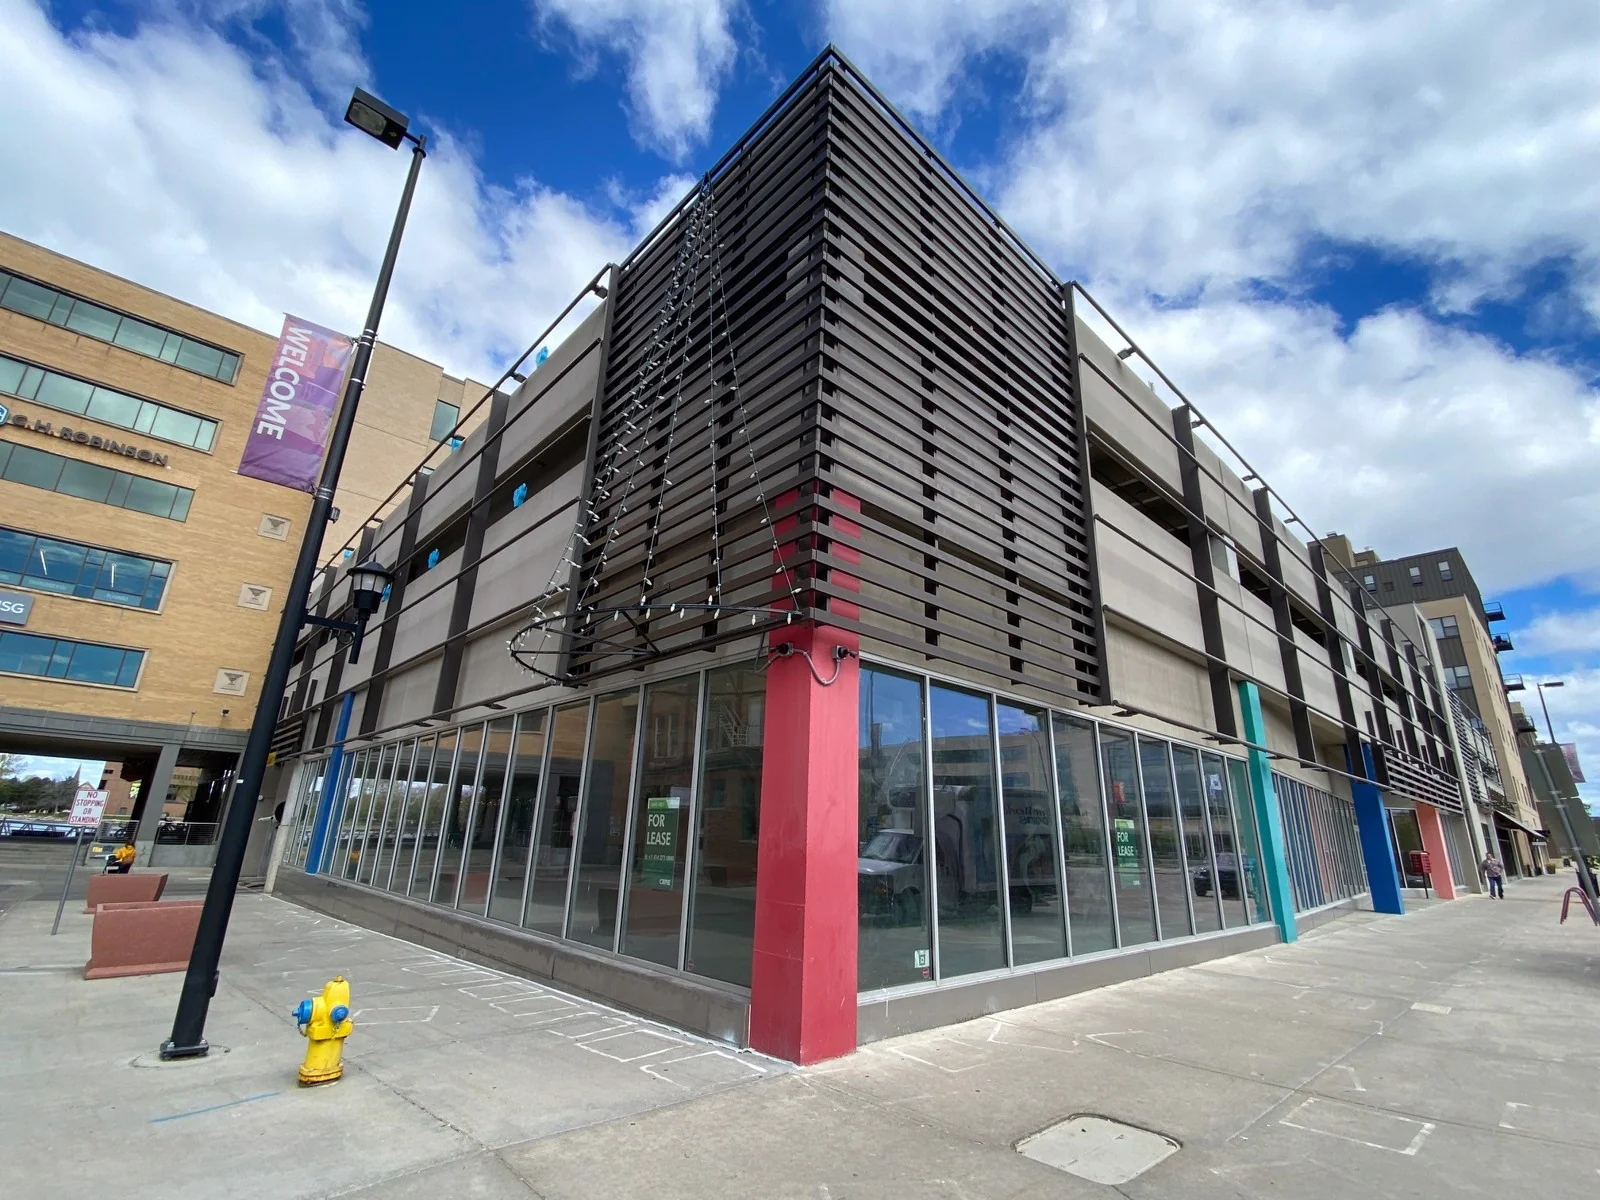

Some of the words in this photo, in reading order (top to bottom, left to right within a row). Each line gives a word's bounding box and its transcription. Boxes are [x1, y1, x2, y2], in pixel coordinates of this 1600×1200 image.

[256, 326, 313, 441] WELCOME
[60, 426, 169, 467] ROBINSON
[86, 791, 98, 799] NO
[75, 799, 104, 807] STOPPING
[70, 816, 100, 824] STANDING
[648, 813, 666, 828] FOR
[646, 831, 672, 846] LEASE
[1117, 832, 1129, 843] FOR
[1118, 846, 1135, 856] LEASE
